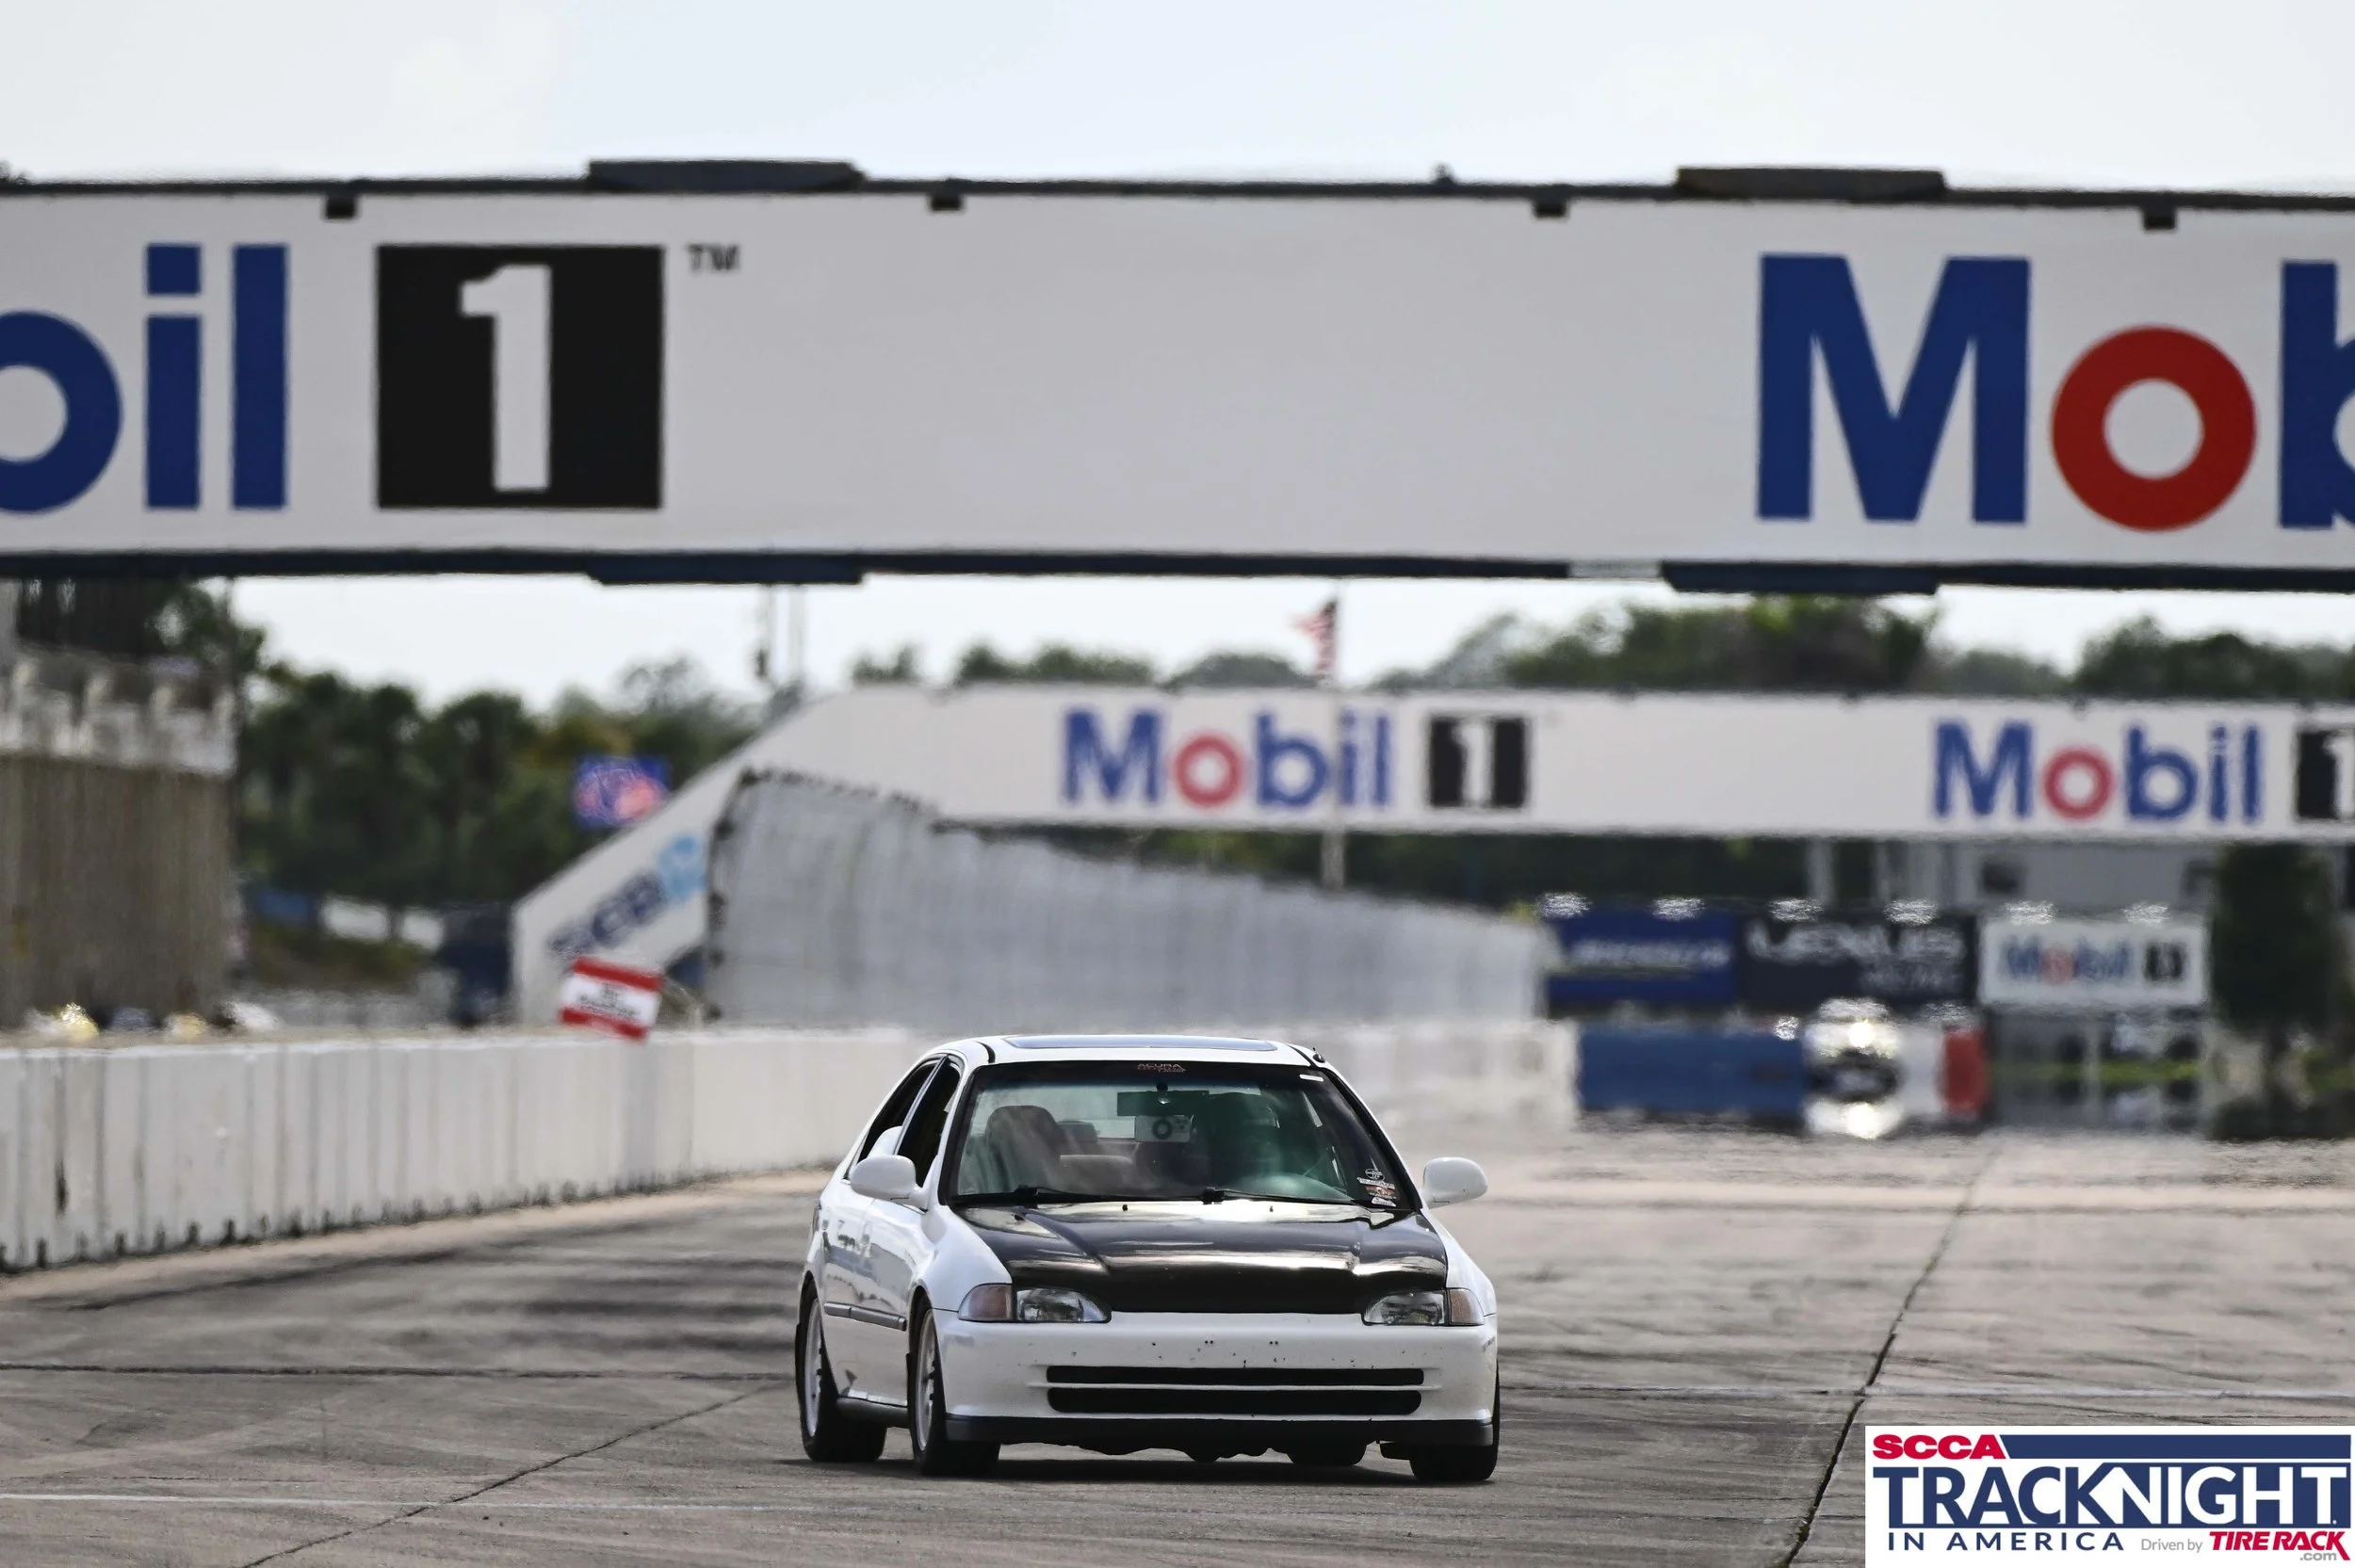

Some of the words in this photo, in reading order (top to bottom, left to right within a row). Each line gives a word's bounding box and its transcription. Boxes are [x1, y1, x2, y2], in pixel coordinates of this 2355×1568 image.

[460, 264, 553, 492] 1
[687, 242, 740, 273] TM
[1062, 708, 1390, 808] Mobil
[1934, 719, 2262, 821] Mobil
